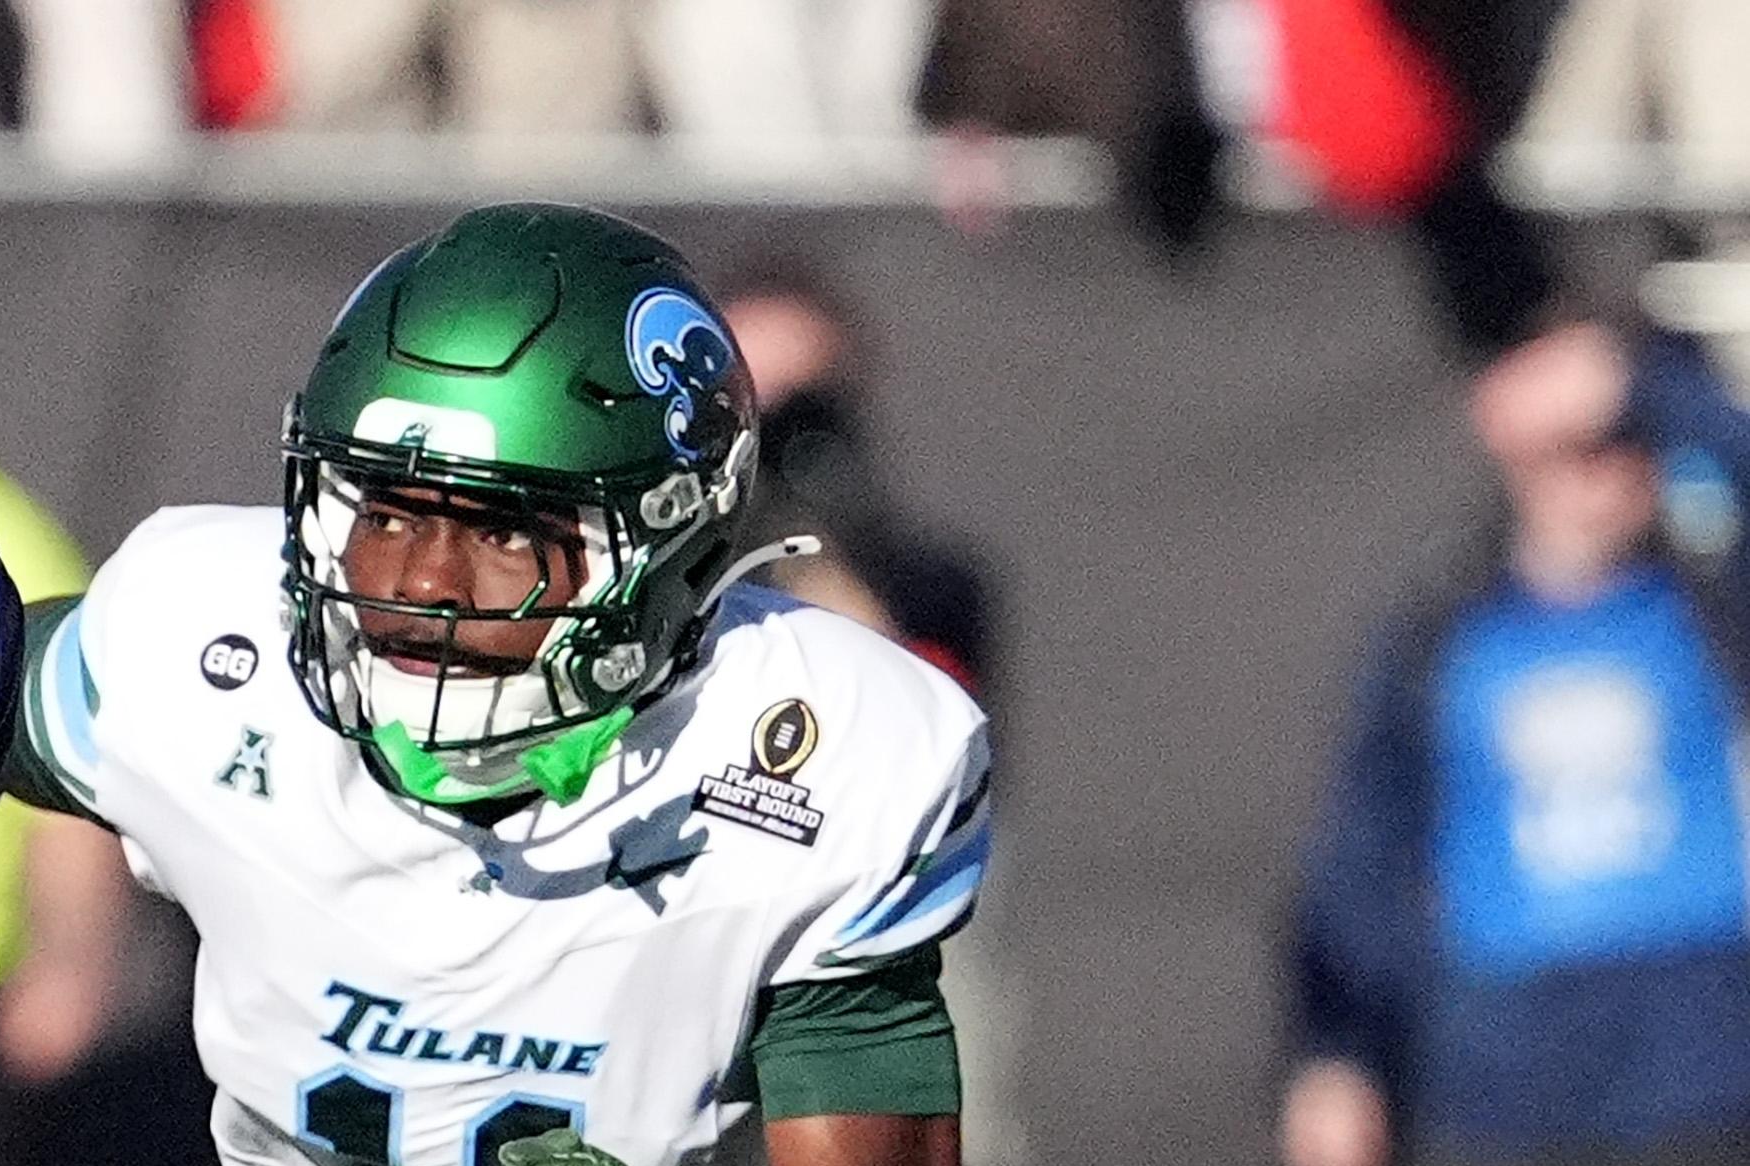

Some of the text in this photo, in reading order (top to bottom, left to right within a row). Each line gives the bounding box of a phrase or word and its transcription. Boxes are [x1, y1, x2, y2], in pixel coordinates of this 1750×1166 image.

[700, 777, 757, 809] FIRST
[755, 794, 822, 829] ROUND
[724, 767, 810, 806] PLAYOFF
[319, 979, 611, 1078] TULANE
